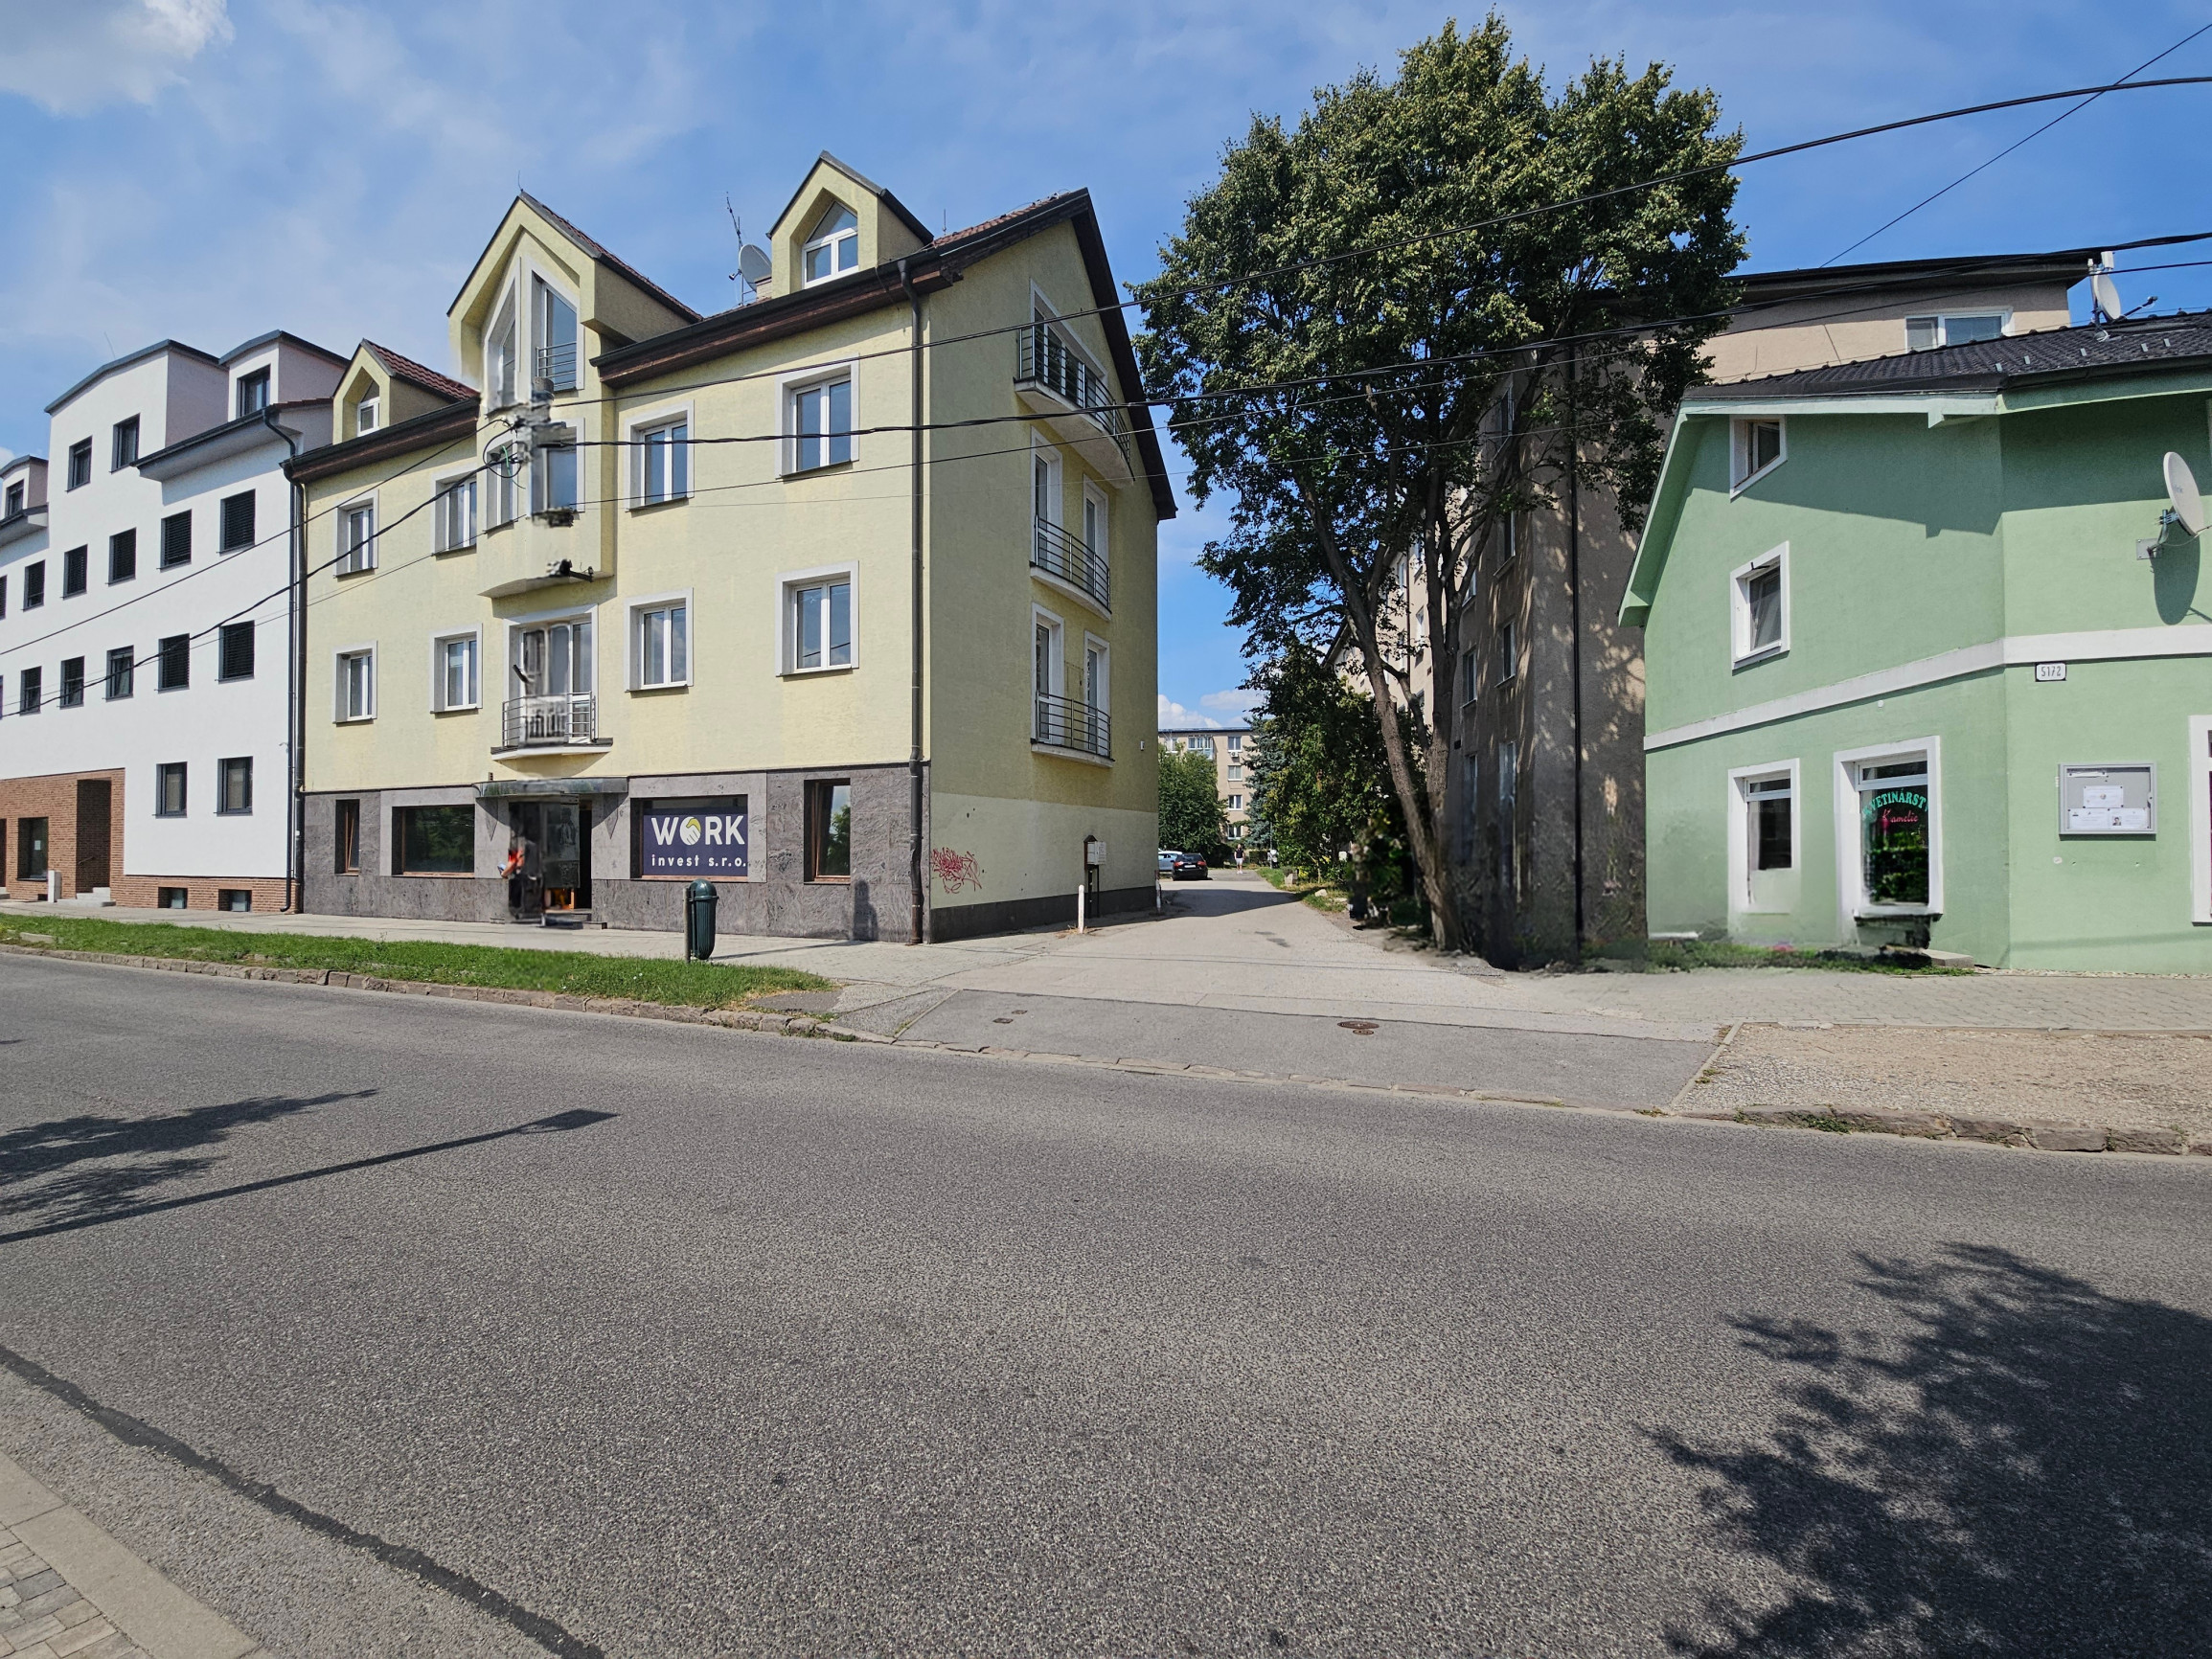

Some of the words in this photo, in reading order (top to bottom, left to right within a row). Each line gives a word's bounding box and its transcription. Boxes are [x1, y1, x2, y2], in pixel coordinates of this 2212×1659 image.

[2041, 666, 2062, 677] 5172
[650, 815, 745, 846] WORK
[651, 854, 699, 867] invest
[708, 856, 746, 867] s.r.o.
